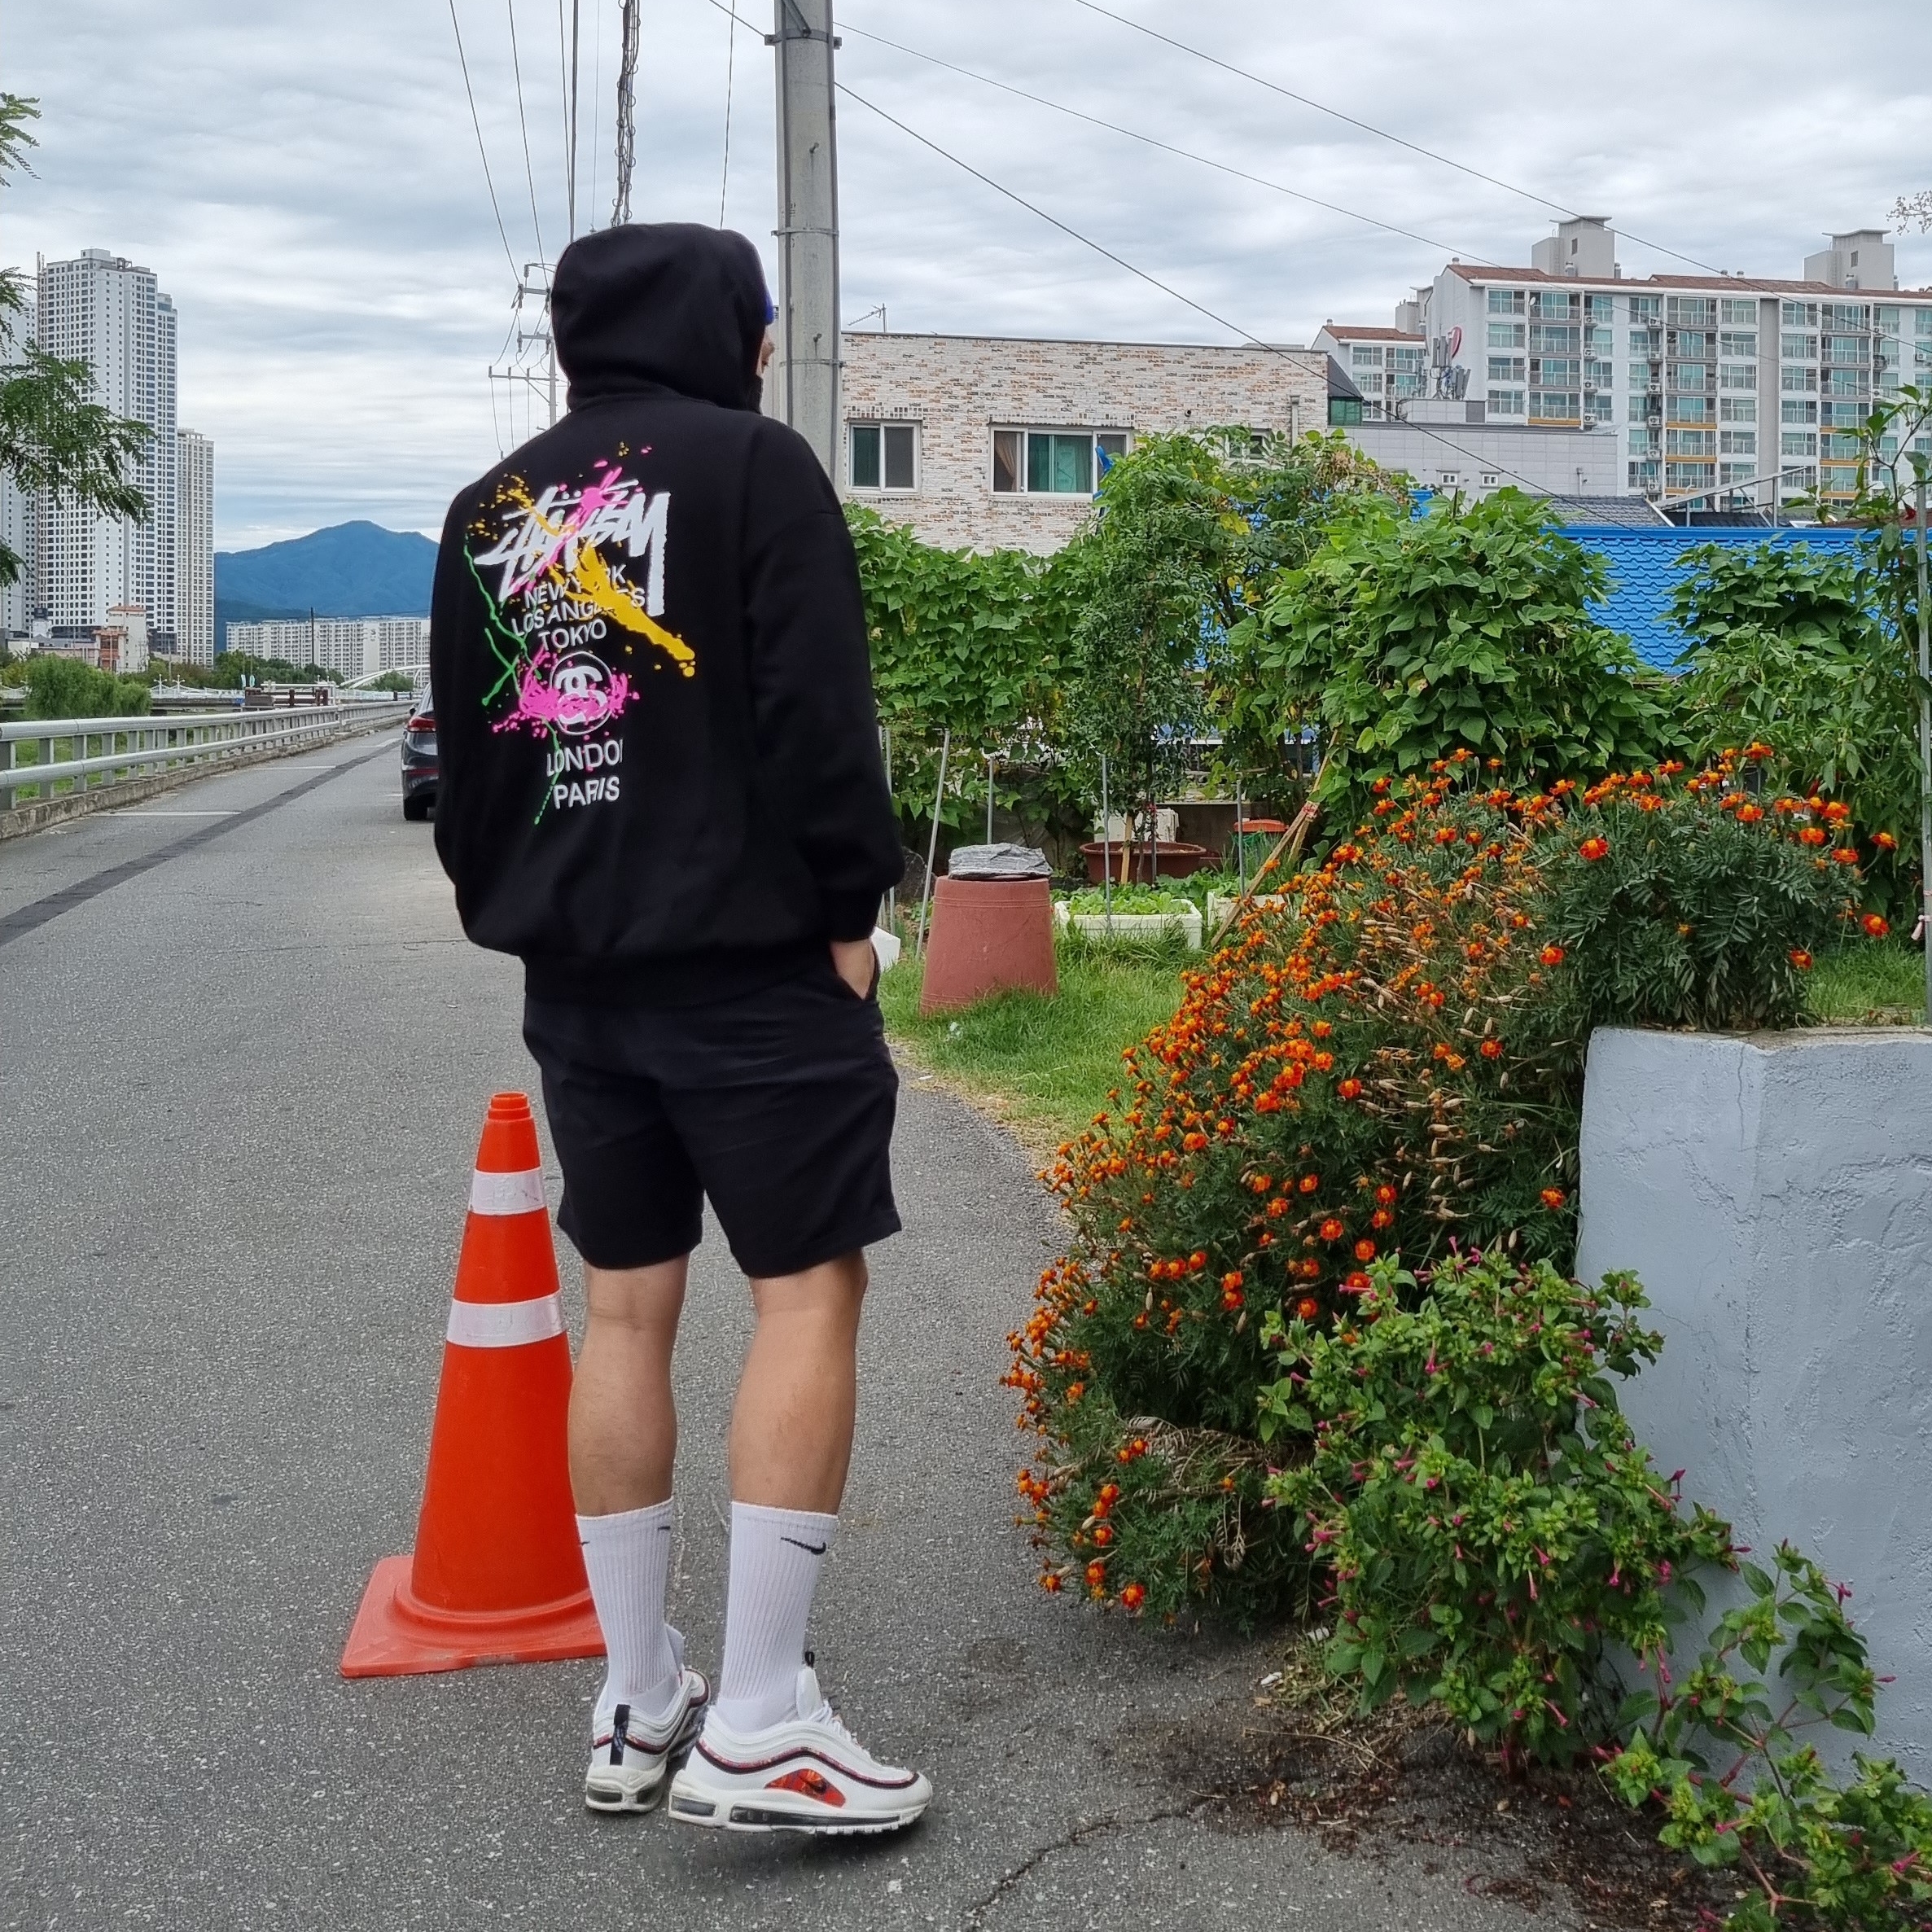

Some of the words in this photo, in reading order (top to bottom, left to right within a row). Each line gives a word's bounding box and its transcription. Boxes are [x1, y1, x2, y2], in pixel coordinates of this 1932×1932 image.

[524, 578, 571, 609] NEW
[511, 608, 545, 637] LOS
[538, 618, 607, 651] TOKYO
[546, 738, 624, 778] LONDO
[553, 776, 620, 809] PARIS
